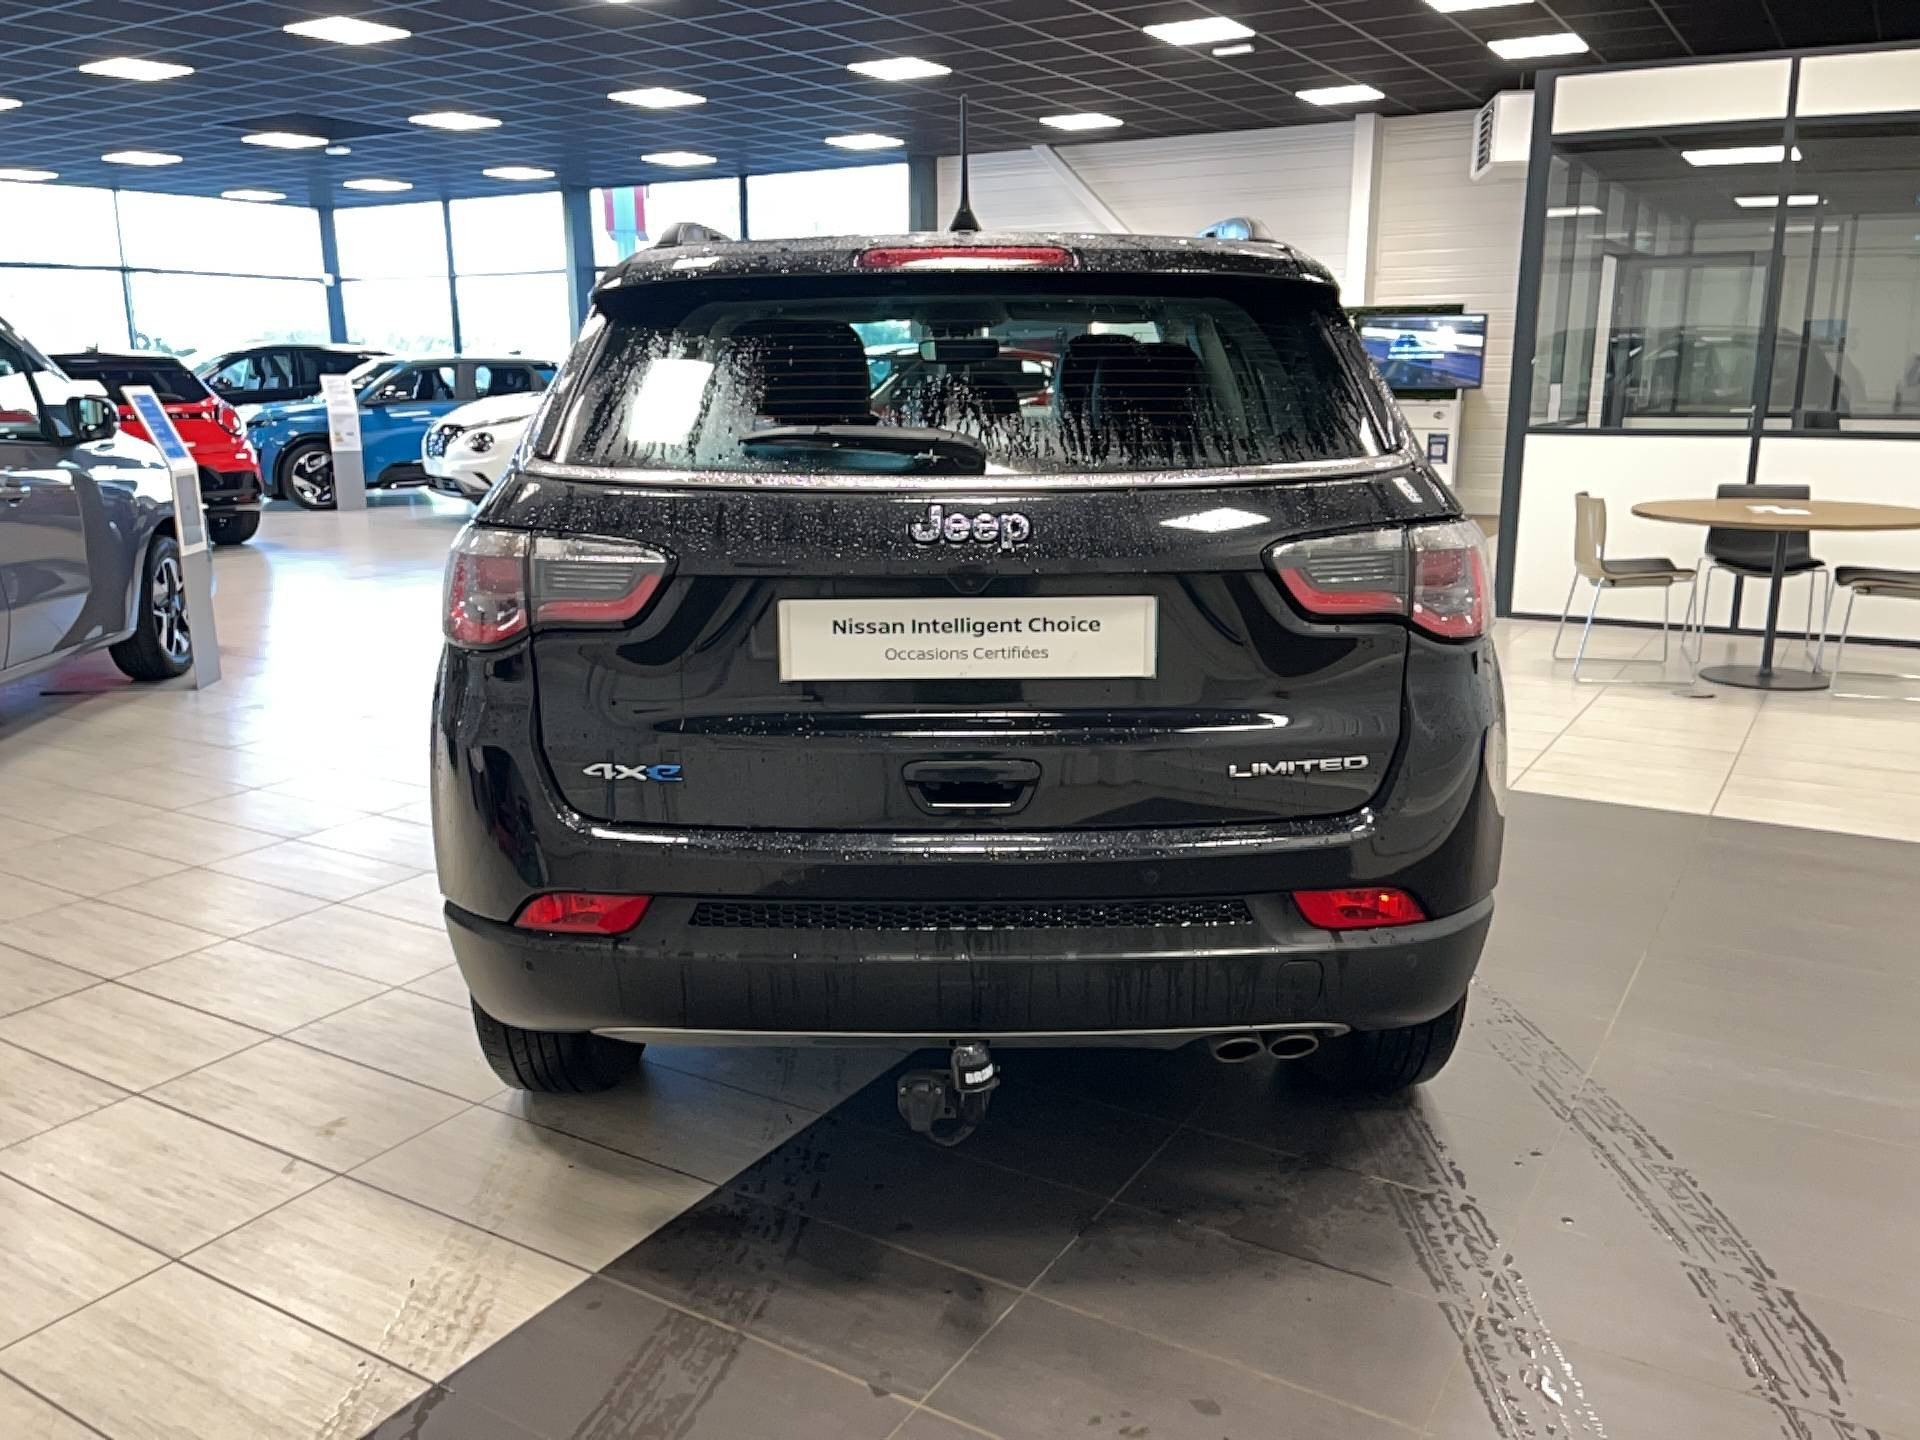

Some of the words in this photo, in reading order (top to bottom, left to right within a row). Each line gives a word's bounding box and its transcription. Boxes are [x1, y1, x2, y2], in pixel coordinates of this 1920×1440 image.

[910, 504, 1030, 549] Jeep
[832, 617, 905, 634] Nissan
[912, 616, 1022, 638] Intelligent
[1028, 615, 1101, 633] Choice
[885, 647, 969, 661] Occasions
[973, 645, 1049, 660] Certifiées
[1228, 755, 1370, 779] LIMITED
